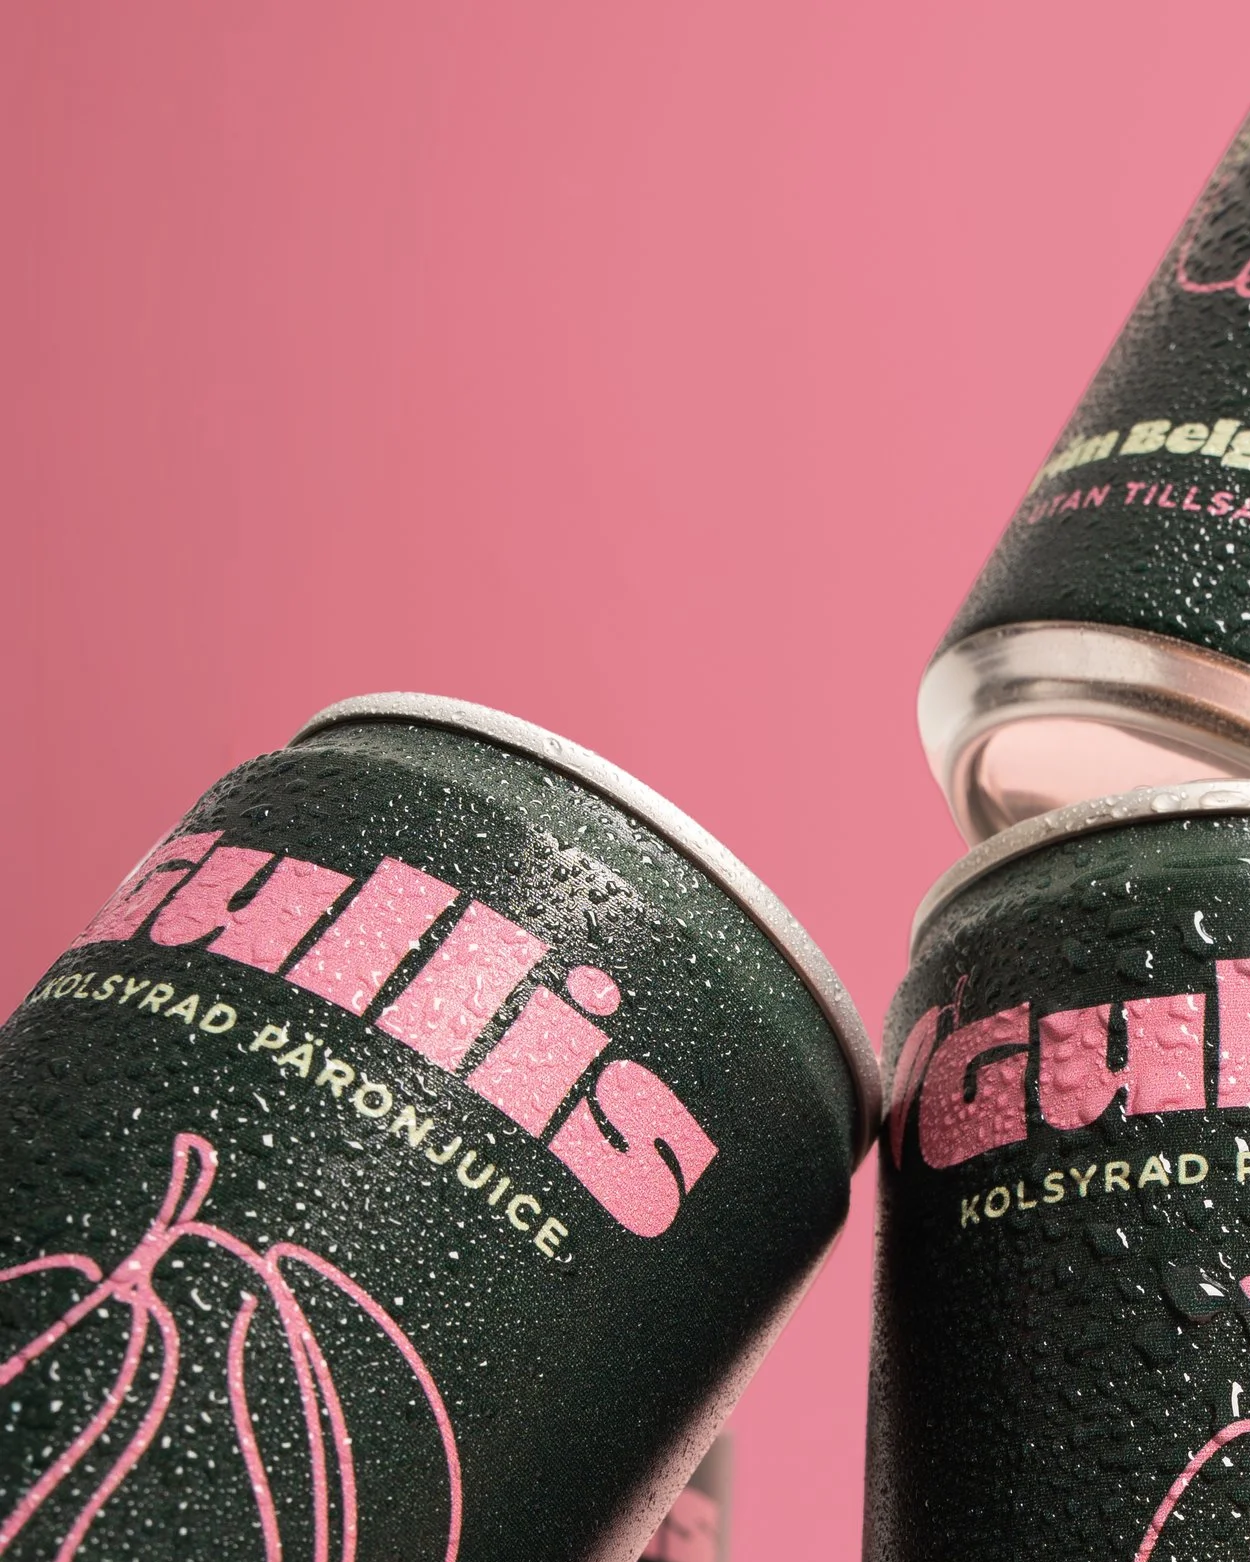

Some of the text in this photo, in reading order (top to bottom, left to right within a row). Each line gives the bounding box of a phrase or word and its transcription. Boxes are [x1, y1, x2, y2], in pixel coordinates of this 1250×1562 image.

[1028, 483, 1112, 526] UTAN
[30, 972, 572, 1262] KOLSYRAD PÄRONJUICE
[960, 1152, 1211, 1229] KOLSYRAD
